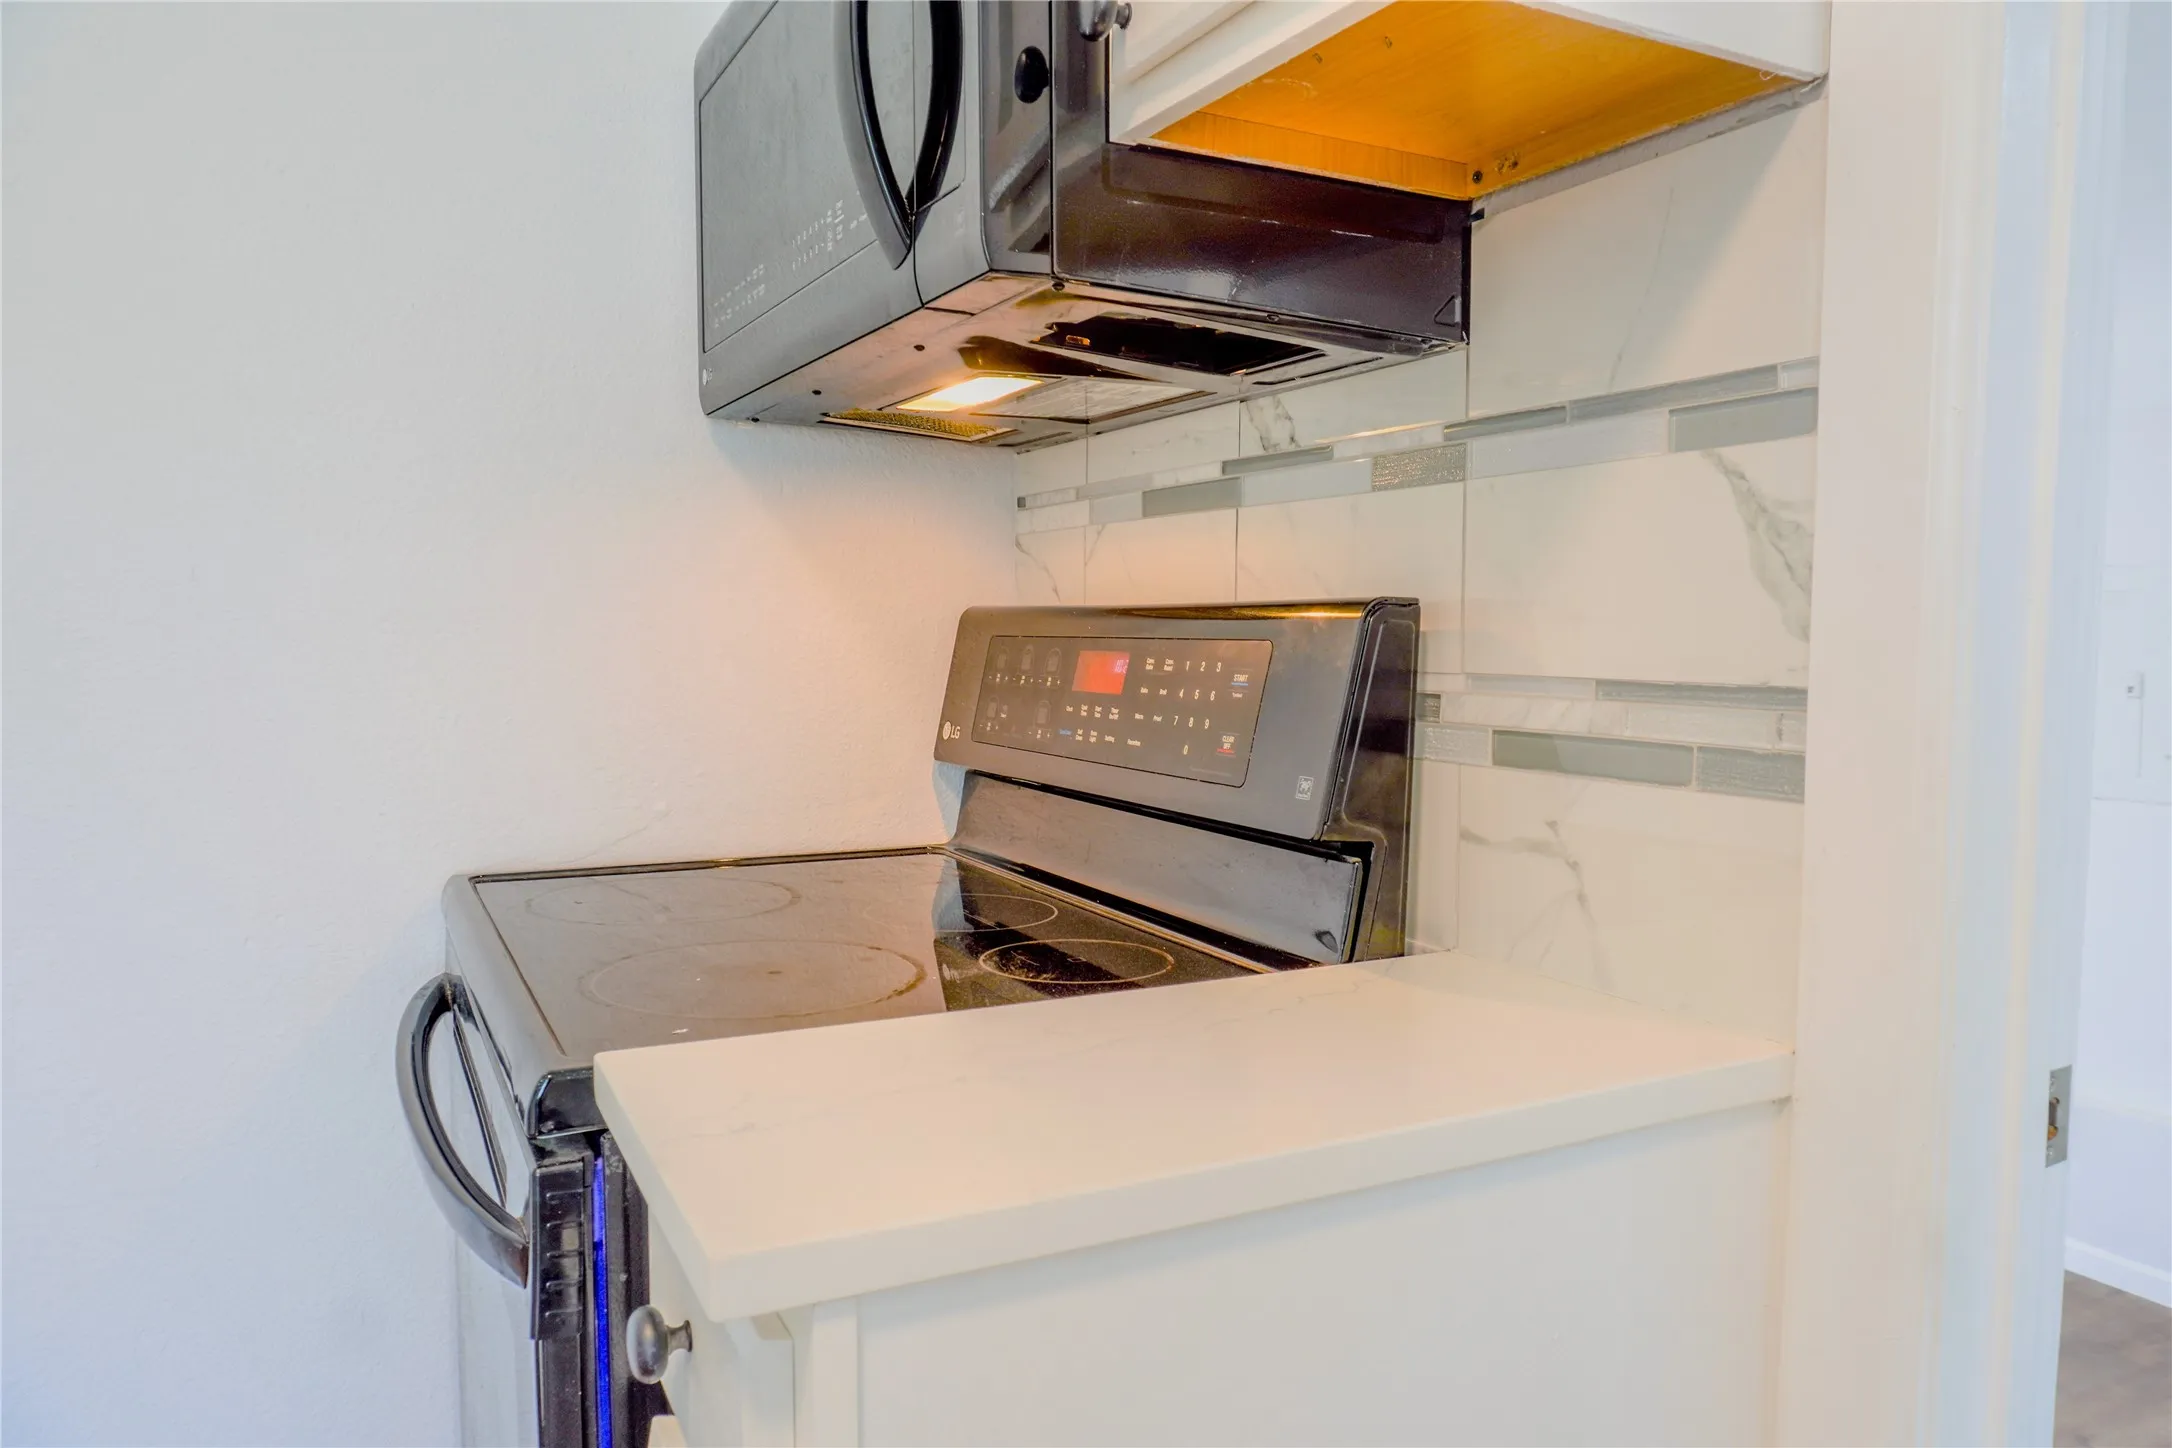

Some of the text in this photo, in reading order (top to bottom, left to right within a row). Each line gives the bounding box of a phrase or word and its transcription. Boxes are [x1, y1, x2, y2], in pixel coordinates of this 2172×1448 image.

[1185, 661, 1222, 672] 1 2 3
[1233, 674, 1249, 682] START
[1178, 688, 1216, 701] 4 5 6
[1173, 715, 1210, 729] 7 8 9
[1183, 745, 1189, 755] 0
